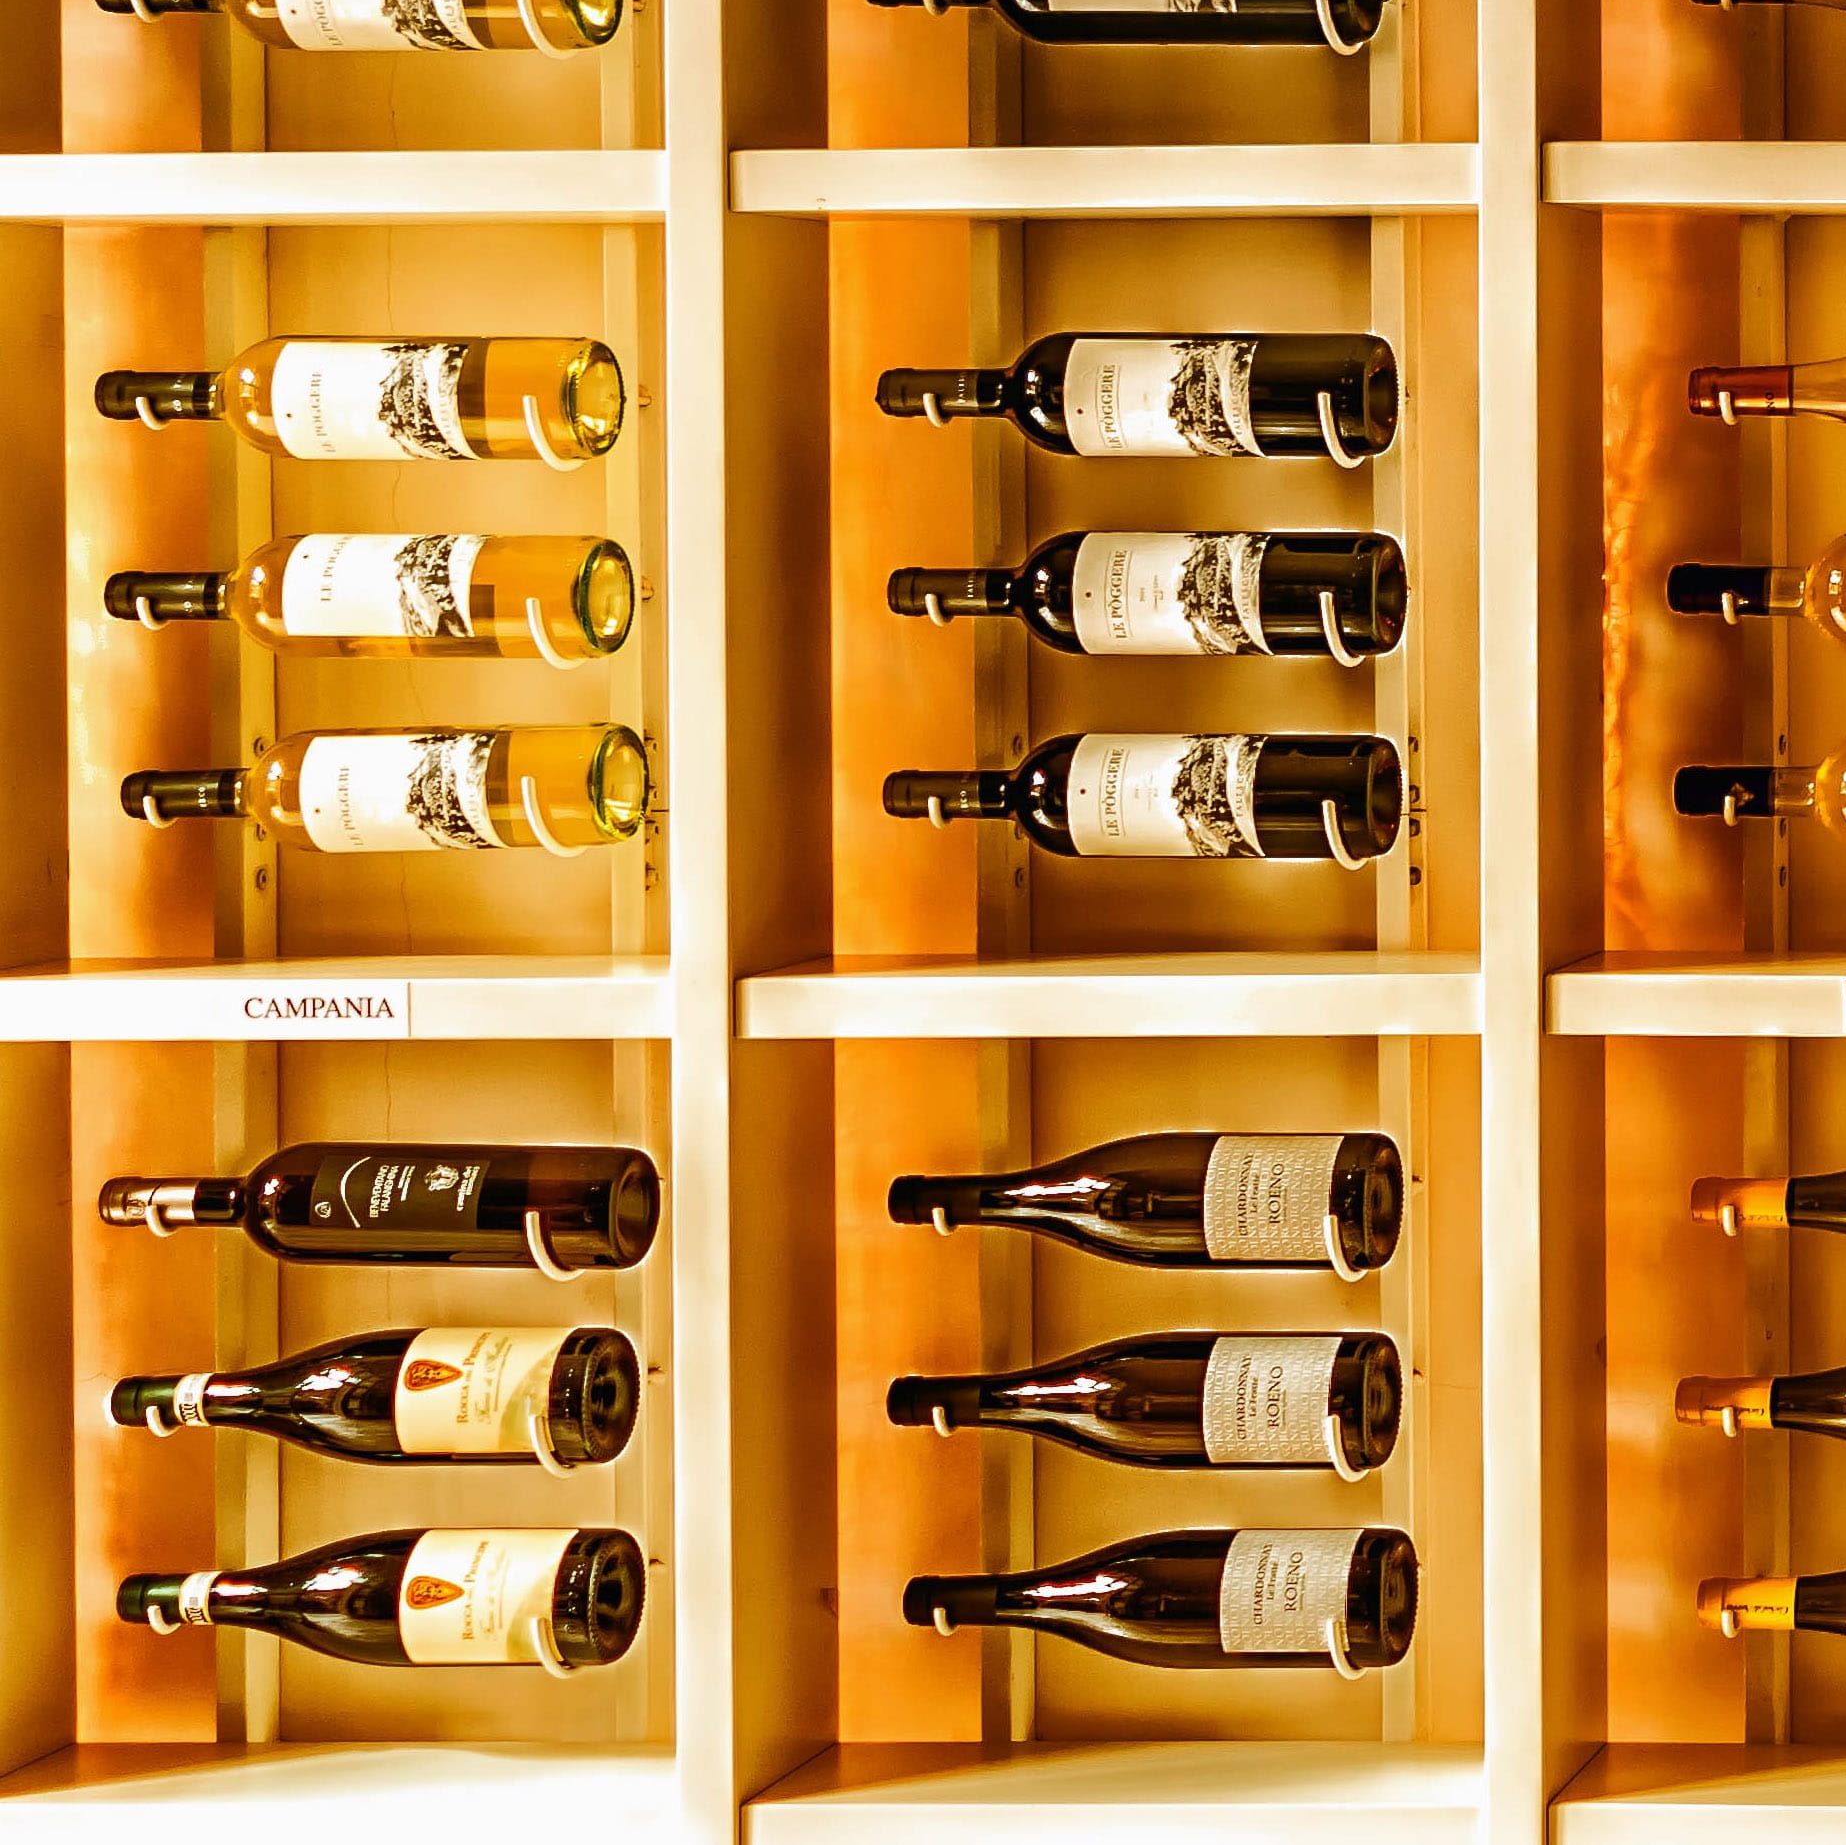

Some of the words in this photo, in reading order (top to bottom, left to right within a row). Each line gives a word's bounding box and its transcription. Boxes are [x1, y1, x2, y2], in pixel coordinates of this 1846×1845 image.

[328, 33, 343, 46] LE
[1097, 365, 1117, 432] PÒGGERE
[1104, 437, 1120, 449] LE
[319, 587, 333, 601] LE
[1107, 551, 1128, 618] PÒGGERE
[1115, 622, 1128, 639] LE
[1102, 748, 1123, 815] PÒGGERE
[1107, 820, 1120, 837] LE
[244, 998, 394, 1018] CAMPANIA
[370, 1165, 389, 1217] BENEVENTANO
[1238, 1152, 1254, 1236] CHARDONNAY
[1250, 1204, 1257, 1213] Le
[1268, 1164, 1284, 1224] ROENO
[456, 1386, 473, 1424] ROCCA
[1236, 1355, 1252, 1440] CHARDONNAY
[1249, 1407, 1256, 1417] Le
[1267, 1366, 1284, 1427] ROENO
[1253, 1543, 1272, 1625] CHARDONNAY
[1267, 1591, 1274, 1600] Le
[1284, 1552, 1303, 1612] ROENO
[462, 1604, 475, 1640] ROCCA
